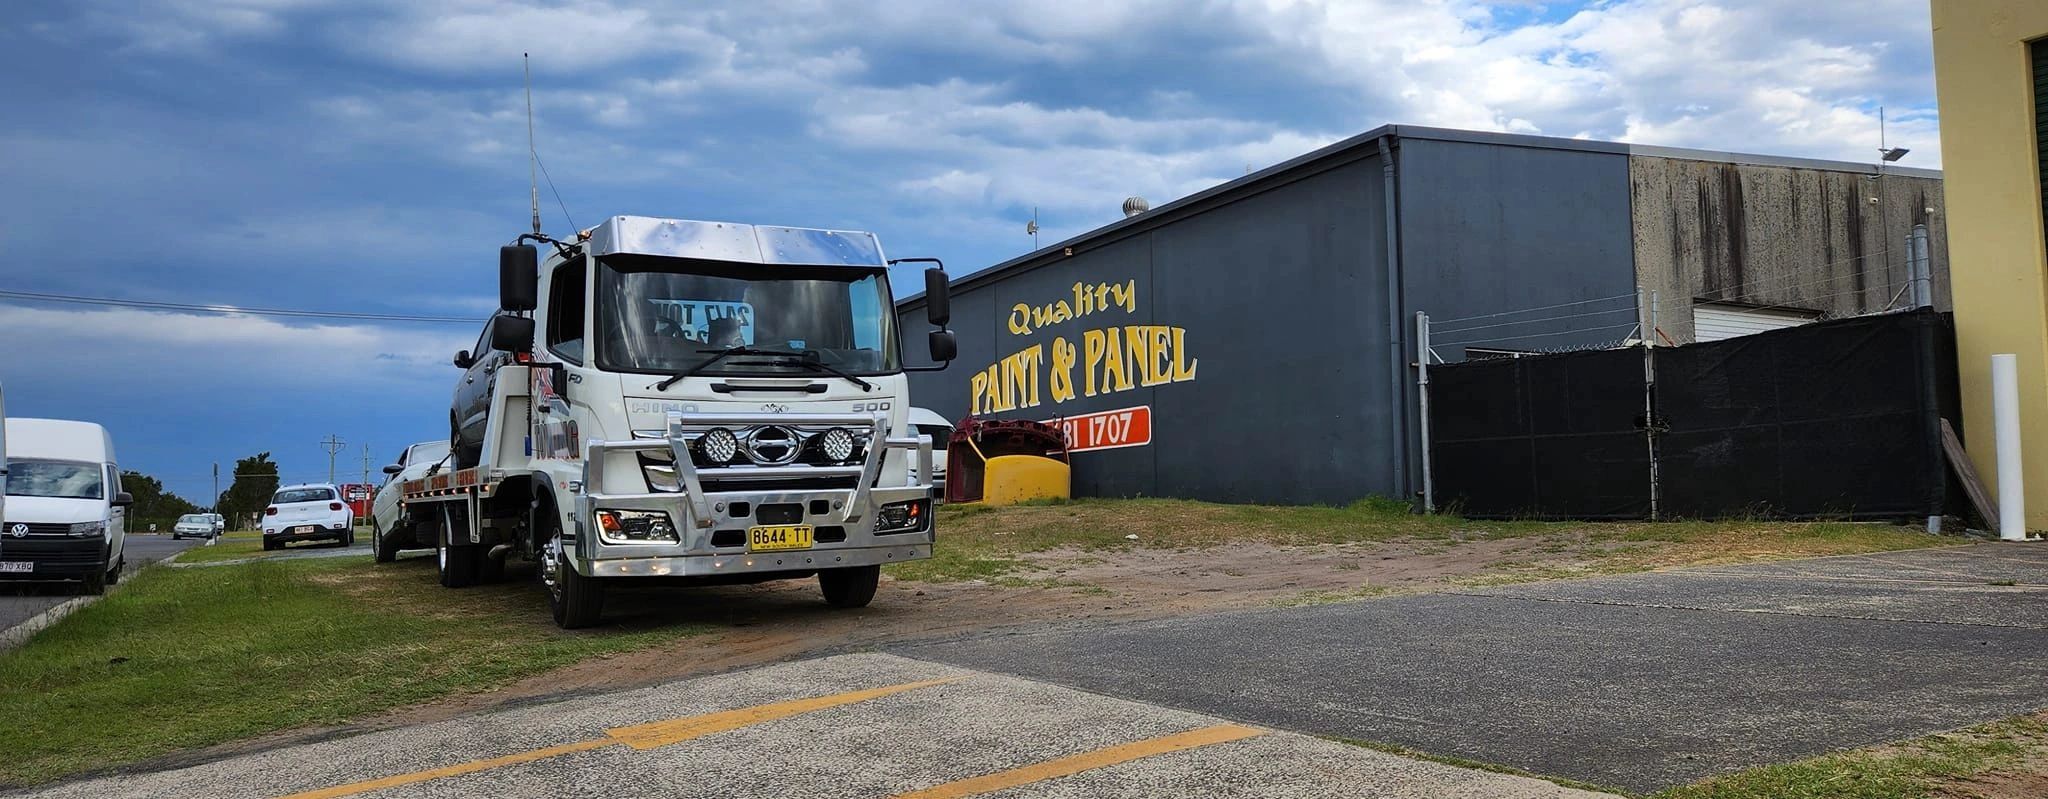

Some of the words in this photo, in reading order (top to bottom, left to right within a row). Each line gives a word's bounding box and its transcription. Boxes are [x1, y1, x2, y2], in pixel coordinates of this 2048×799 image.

[1008, 279, 1136, 335] Quality
[970, 343, 1043, 416] PAINT
[1050, 336, 1076, 403] &
[1083, 325, 1198, 397] PANEL
[568, 373, 582, 384] FD
[632, 402, 699, 413] HINO
[852, 401, 891, 413] 500
[1089, 412, 1133, 446] 1707
[753, 530, 785, 544] 8644
